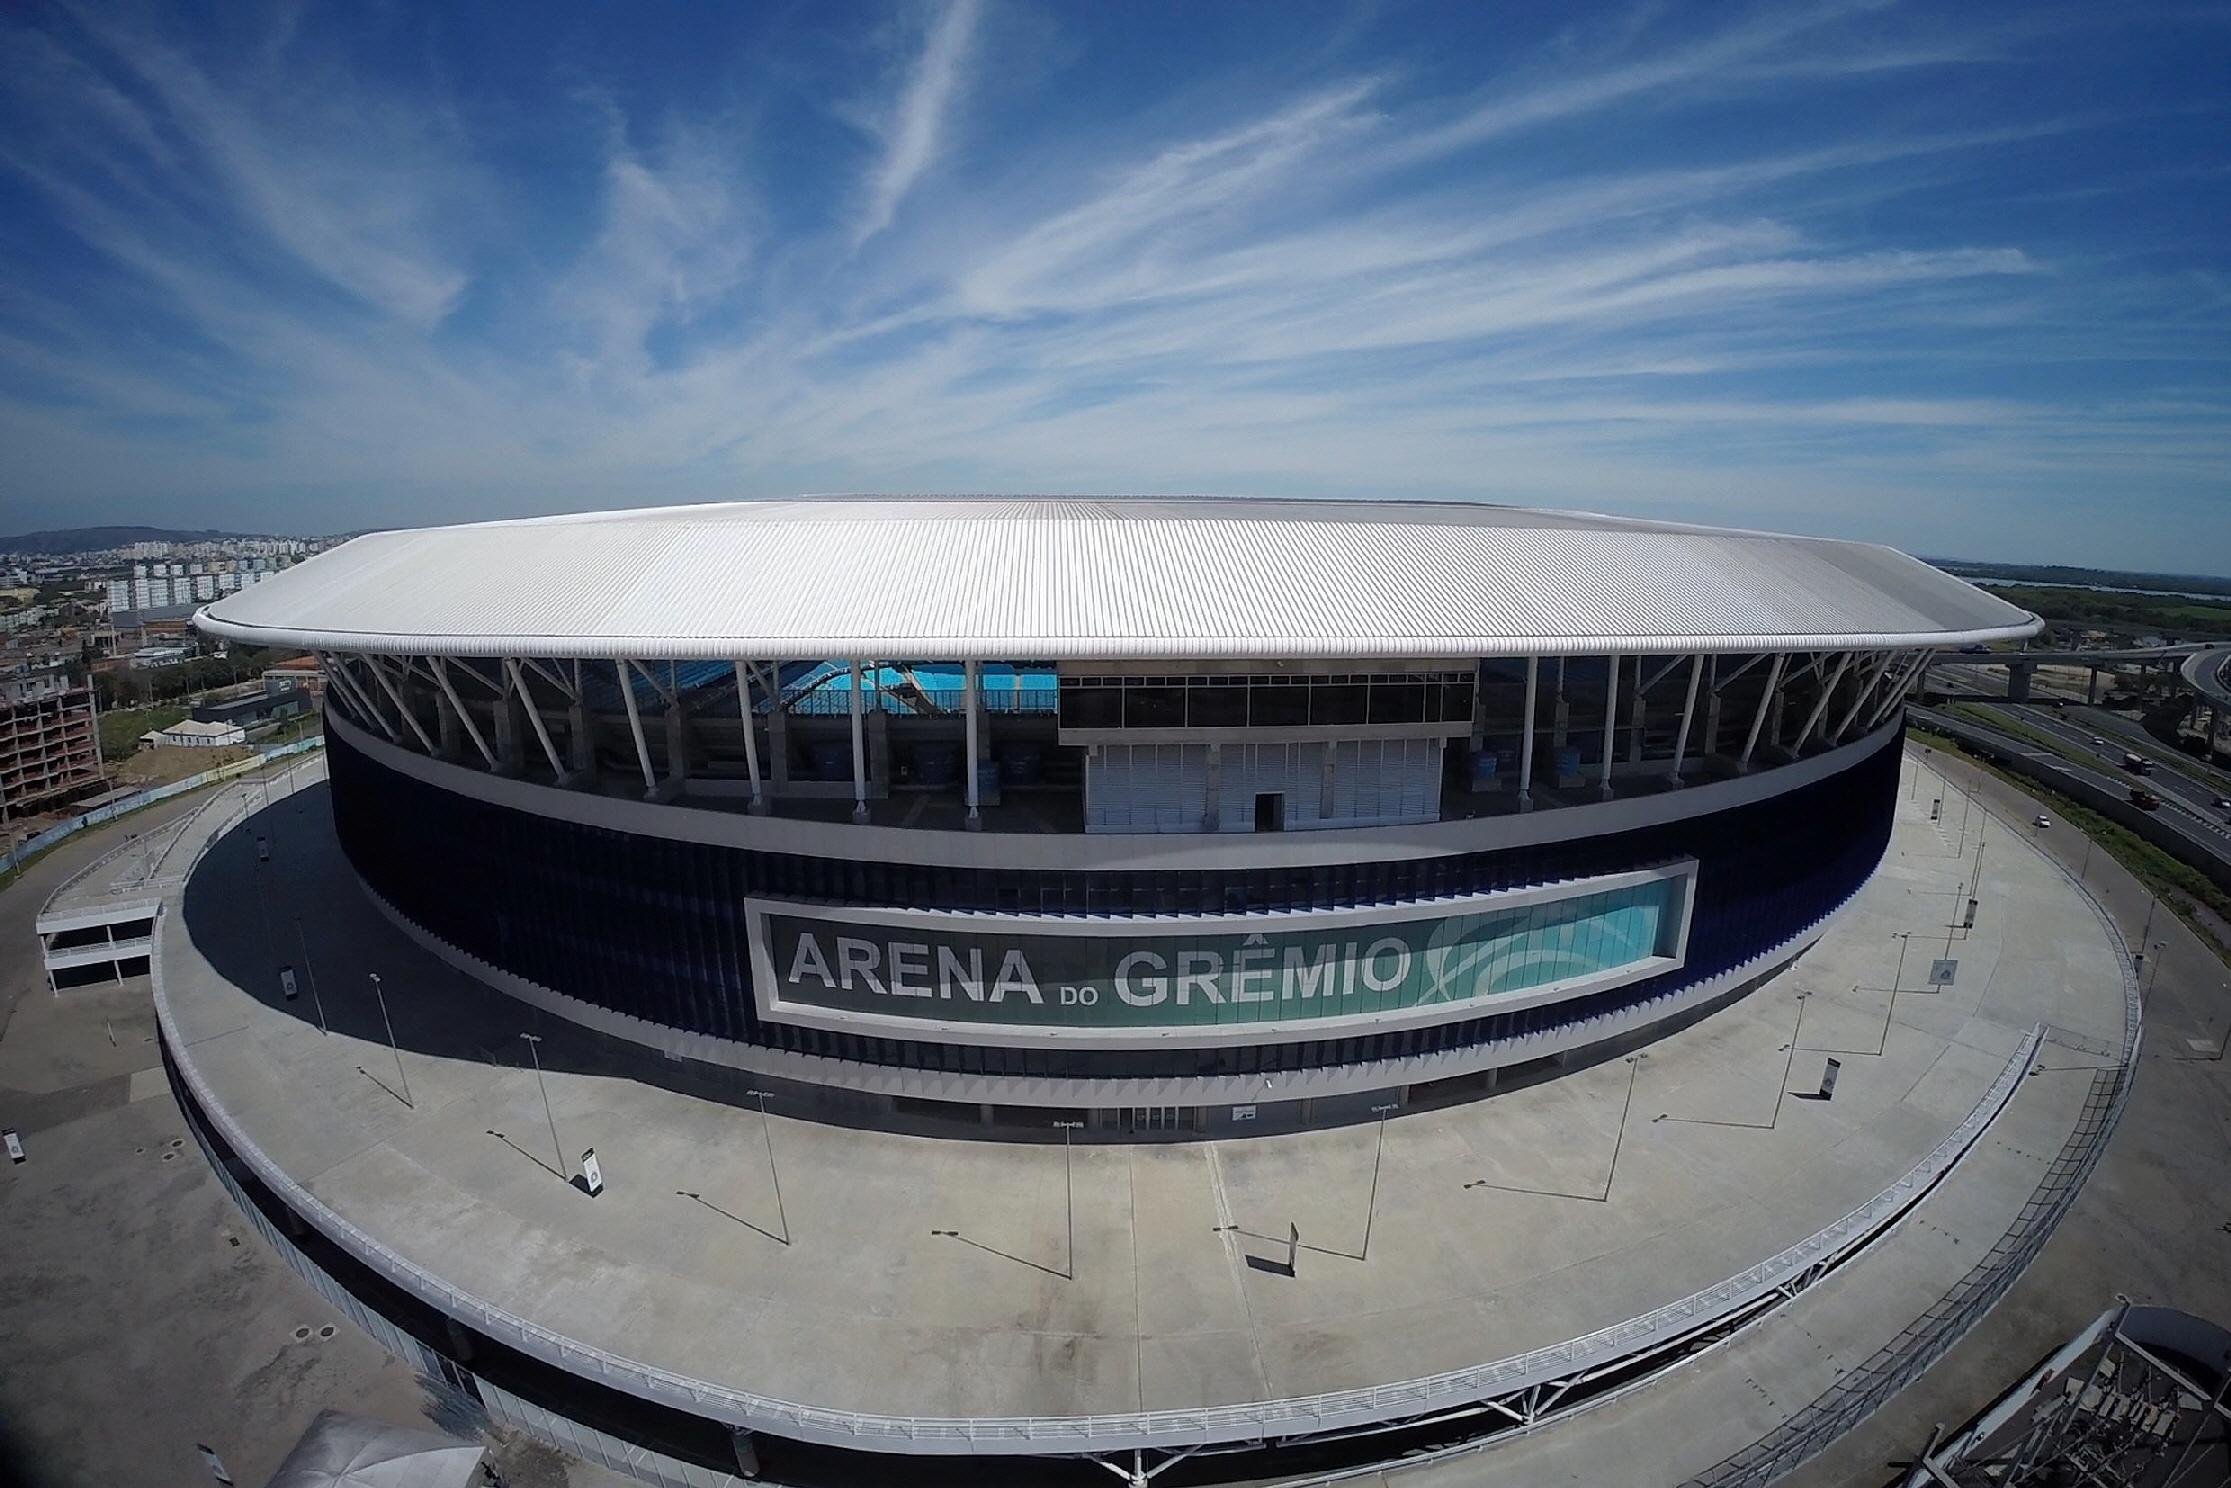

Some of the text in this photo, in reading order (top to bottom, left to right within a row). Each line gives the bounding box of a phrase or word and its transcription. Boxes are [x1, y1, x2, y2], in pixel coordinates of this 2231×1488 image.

[788, 932, 1412, 1007] ARENA DO GRÊMIO
